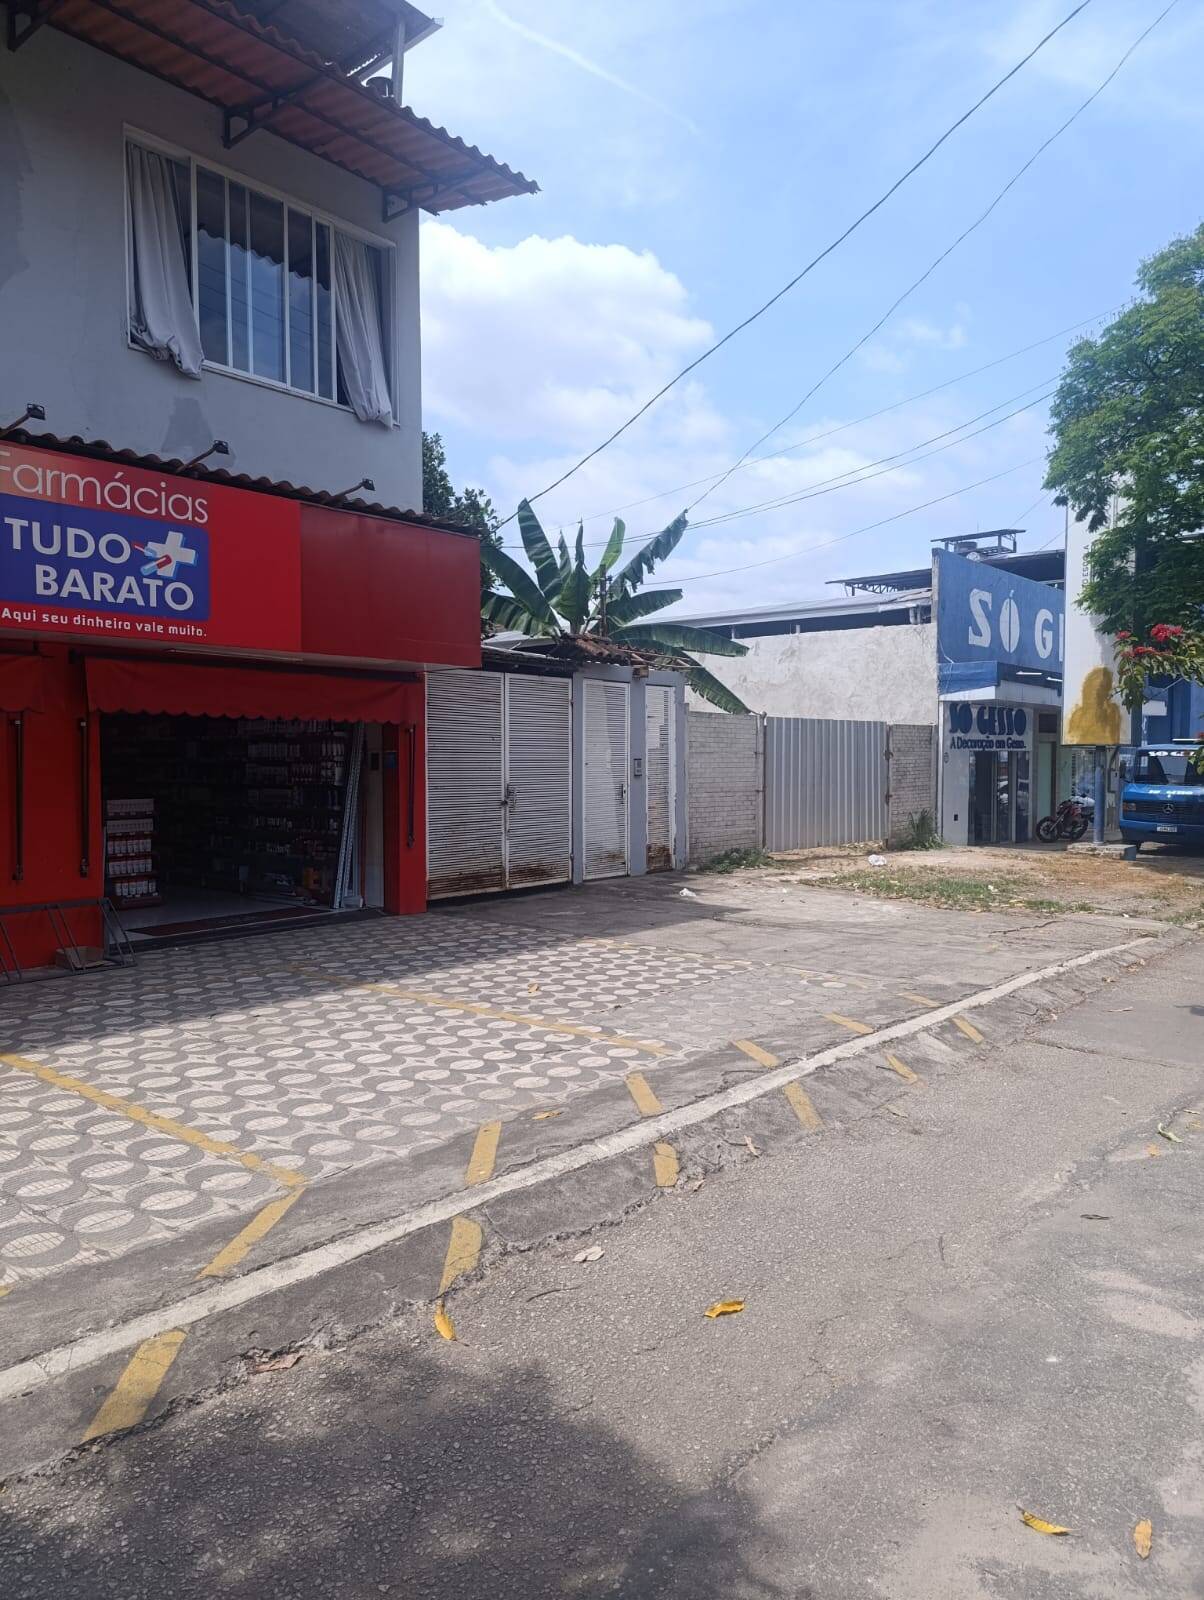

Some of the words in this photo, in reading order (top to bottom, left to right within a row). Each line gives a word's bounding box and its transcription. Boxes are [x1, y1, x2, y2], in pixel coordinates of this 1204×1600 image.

[4, 517, 132, 565] TUDO
[35, 564, 194, 612] BARATO
[1, 608, 36, 623] Aqui
[42, 612, 69, 625] seu
[73, 614, 131, 631] dinheiro
[136, 621, 164, 634] vale
[168, 625, 208, 638] muito.
[968, 588, 1020, 654] SÓ
[977, 705, 1027, 736] GESSO
[950, 736, 957, 749] A
